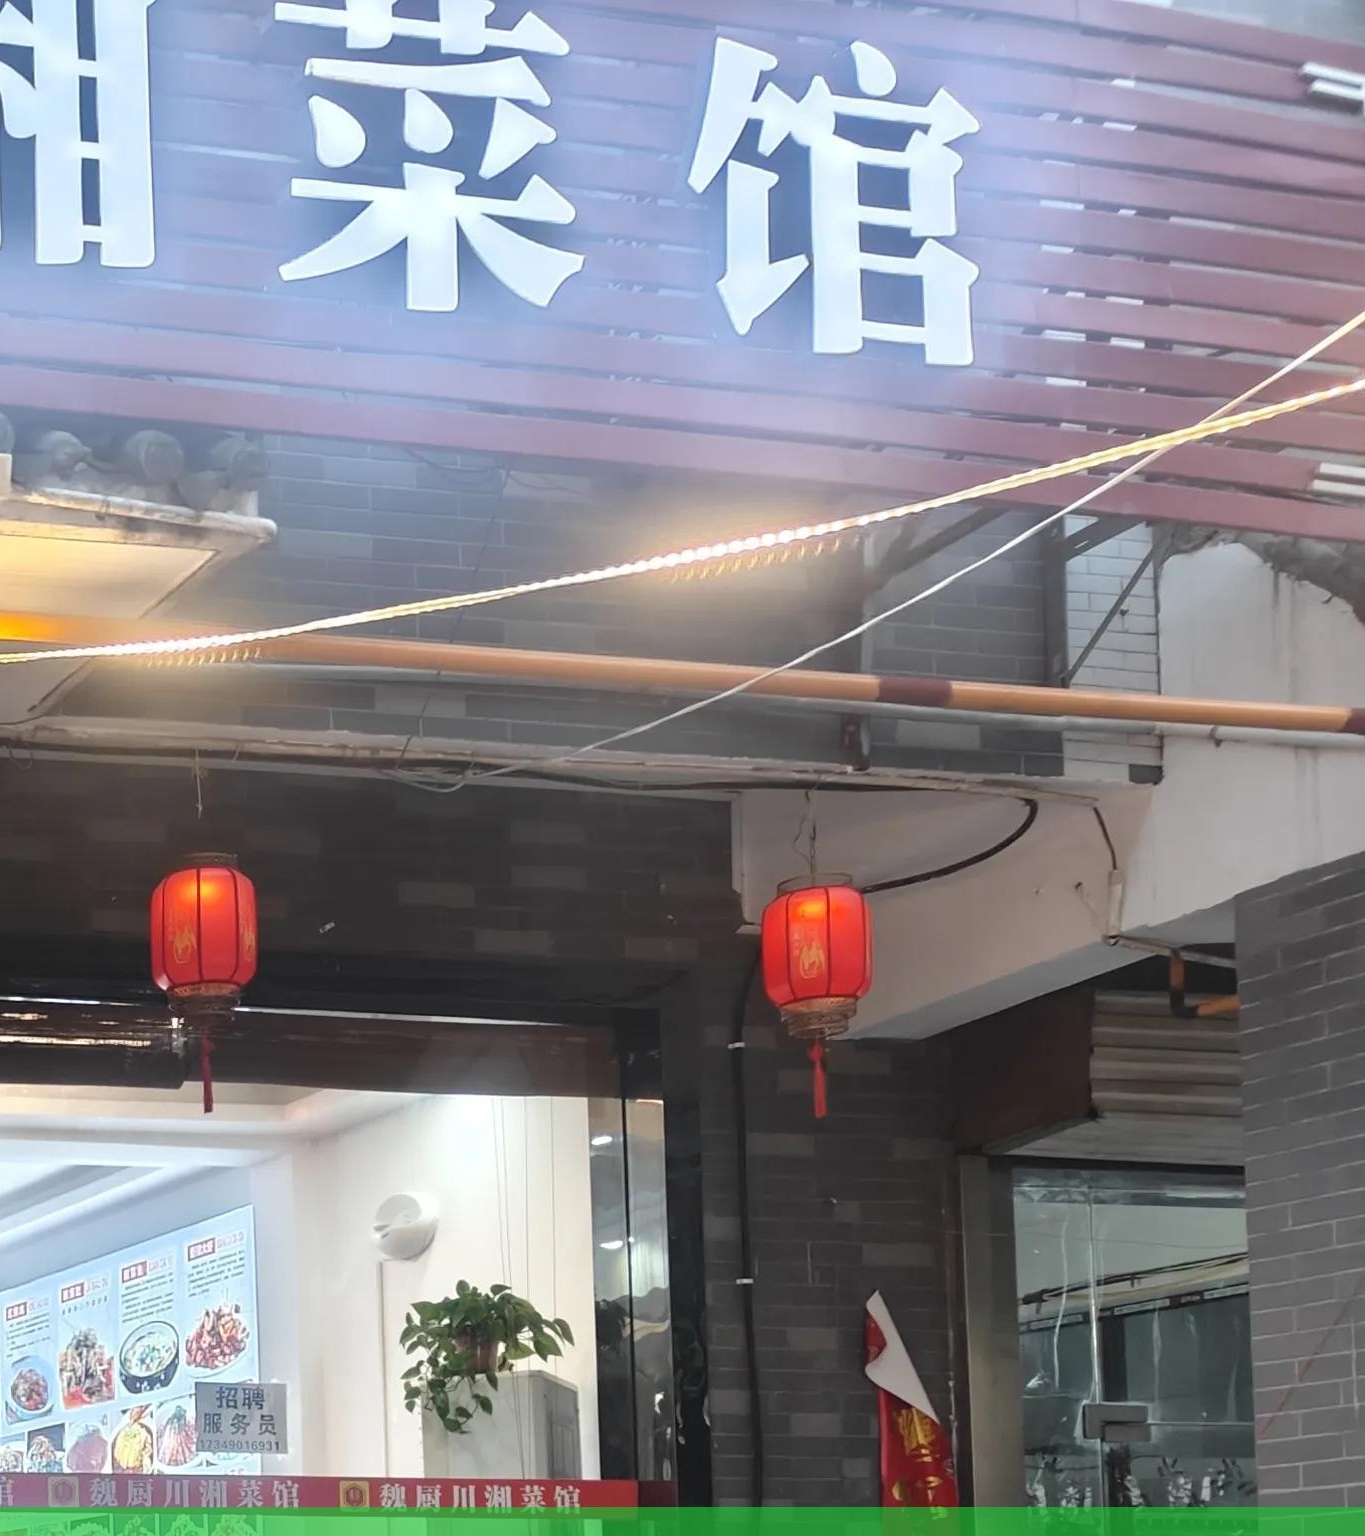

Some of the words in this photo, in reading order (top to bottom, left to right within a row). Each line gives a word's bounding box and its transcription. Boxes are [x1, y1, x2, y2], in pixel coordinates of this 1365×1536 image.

[215, 1386, 266, 1410] 招聘
[202, 1413, 277, 1436] 服务员
[89, 1478, 300, 1508] 魏厨川湘菜馆
[379, 1483, 581, 1514] 魏厨川湘菜馆
